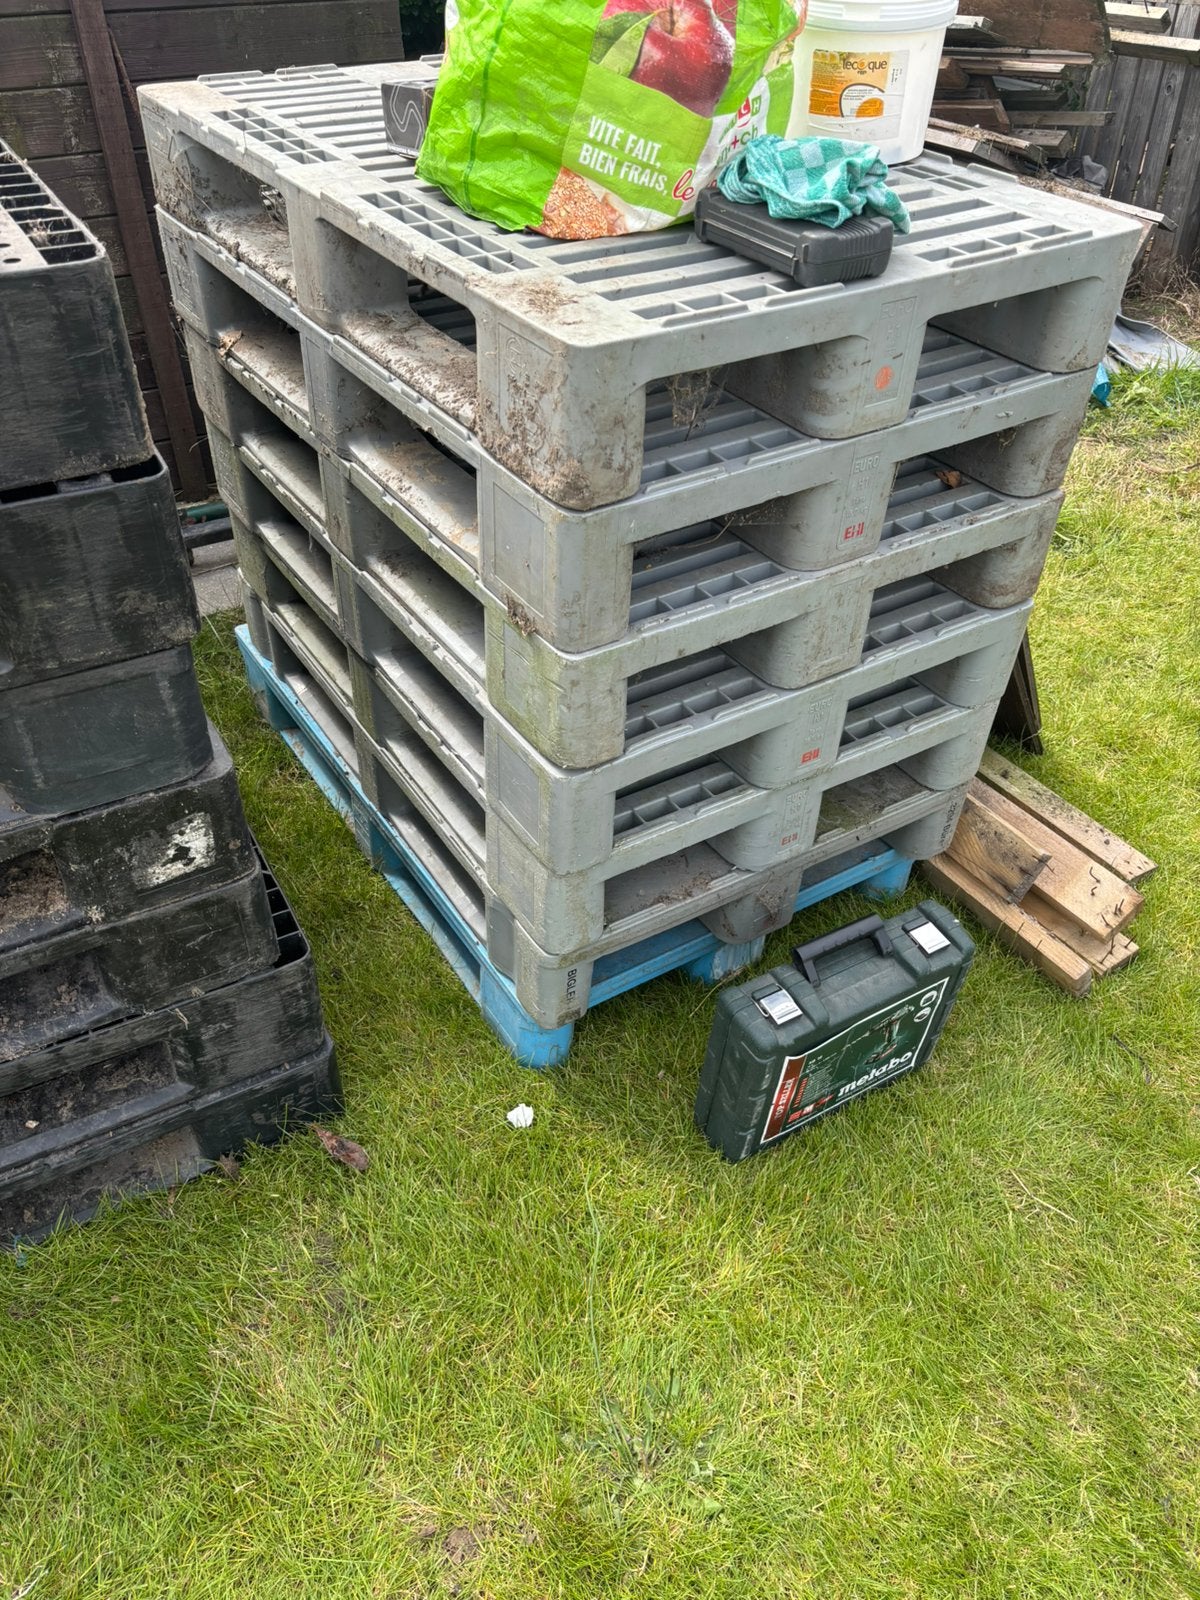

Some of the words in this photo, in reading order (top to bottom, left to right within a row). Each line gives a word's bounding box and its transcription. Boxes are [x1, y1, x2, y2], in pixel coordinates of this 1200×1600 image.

[587, 115, 625, 150] VITE
[624, 133, 662, 169] FAIT,
[578, 142, 618, 177] BIEN
[619, 161, 668, 197] FRAIS,
[837, 1051, 913, 1097] metabo
